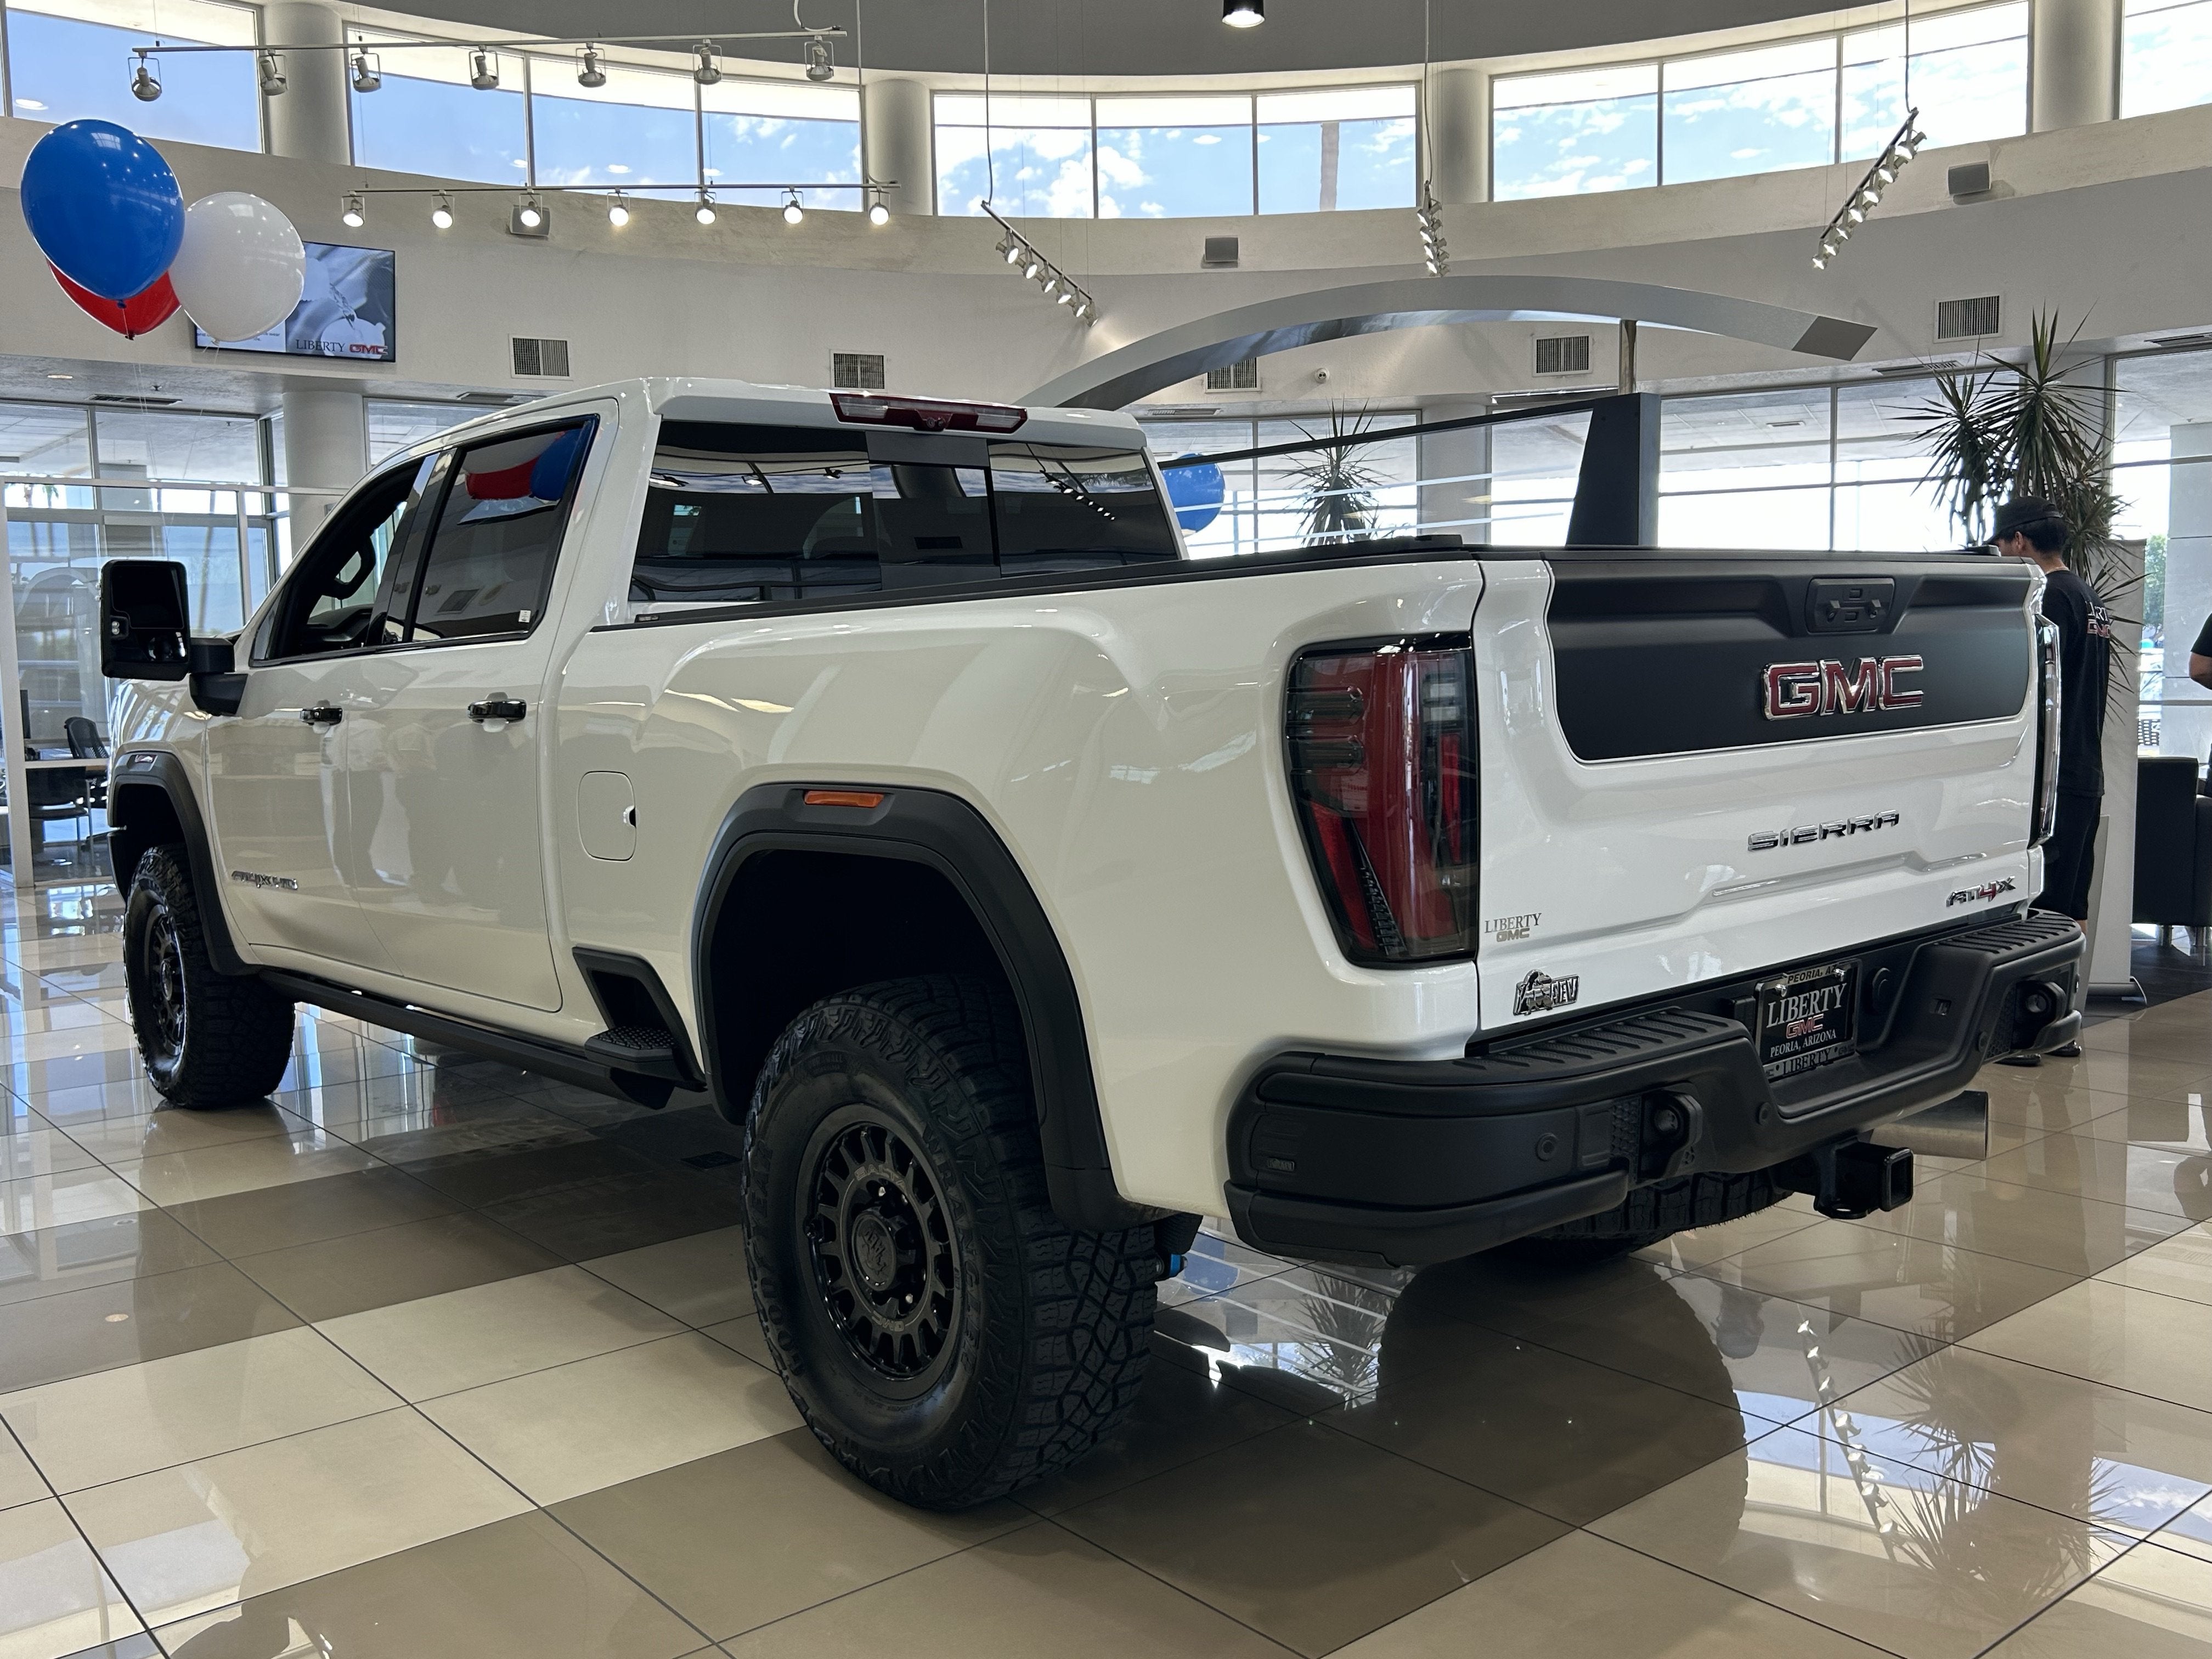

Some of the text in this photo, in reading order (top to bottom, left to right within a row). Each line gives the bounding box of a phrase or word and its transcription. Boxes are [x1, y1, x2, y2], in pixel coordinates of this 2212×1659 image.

[296, 338, 388, 356] LIBERTY GMC
[1763, 654, 1923, 720] GMC
[1748, 809, 1899, 852] SIERRA
[1946, 875, 2016, 907] AT4X
[1485, 912, 1542, 933] LIBERTY
[1496, 928, 1530, 943] GMC
[1787, 969, 1822, 984] PEORIA,
[1766, 983, 1847, 1029] LIBERTY
[1786, 1013, 1824, 1039] GMC
[1770, 1028, 1837, 1058] PEORIA, ARIZONA
[1783, 1047, 1831, 1075] LIBERTY
[871, 1310, 905, 1333] GMC
